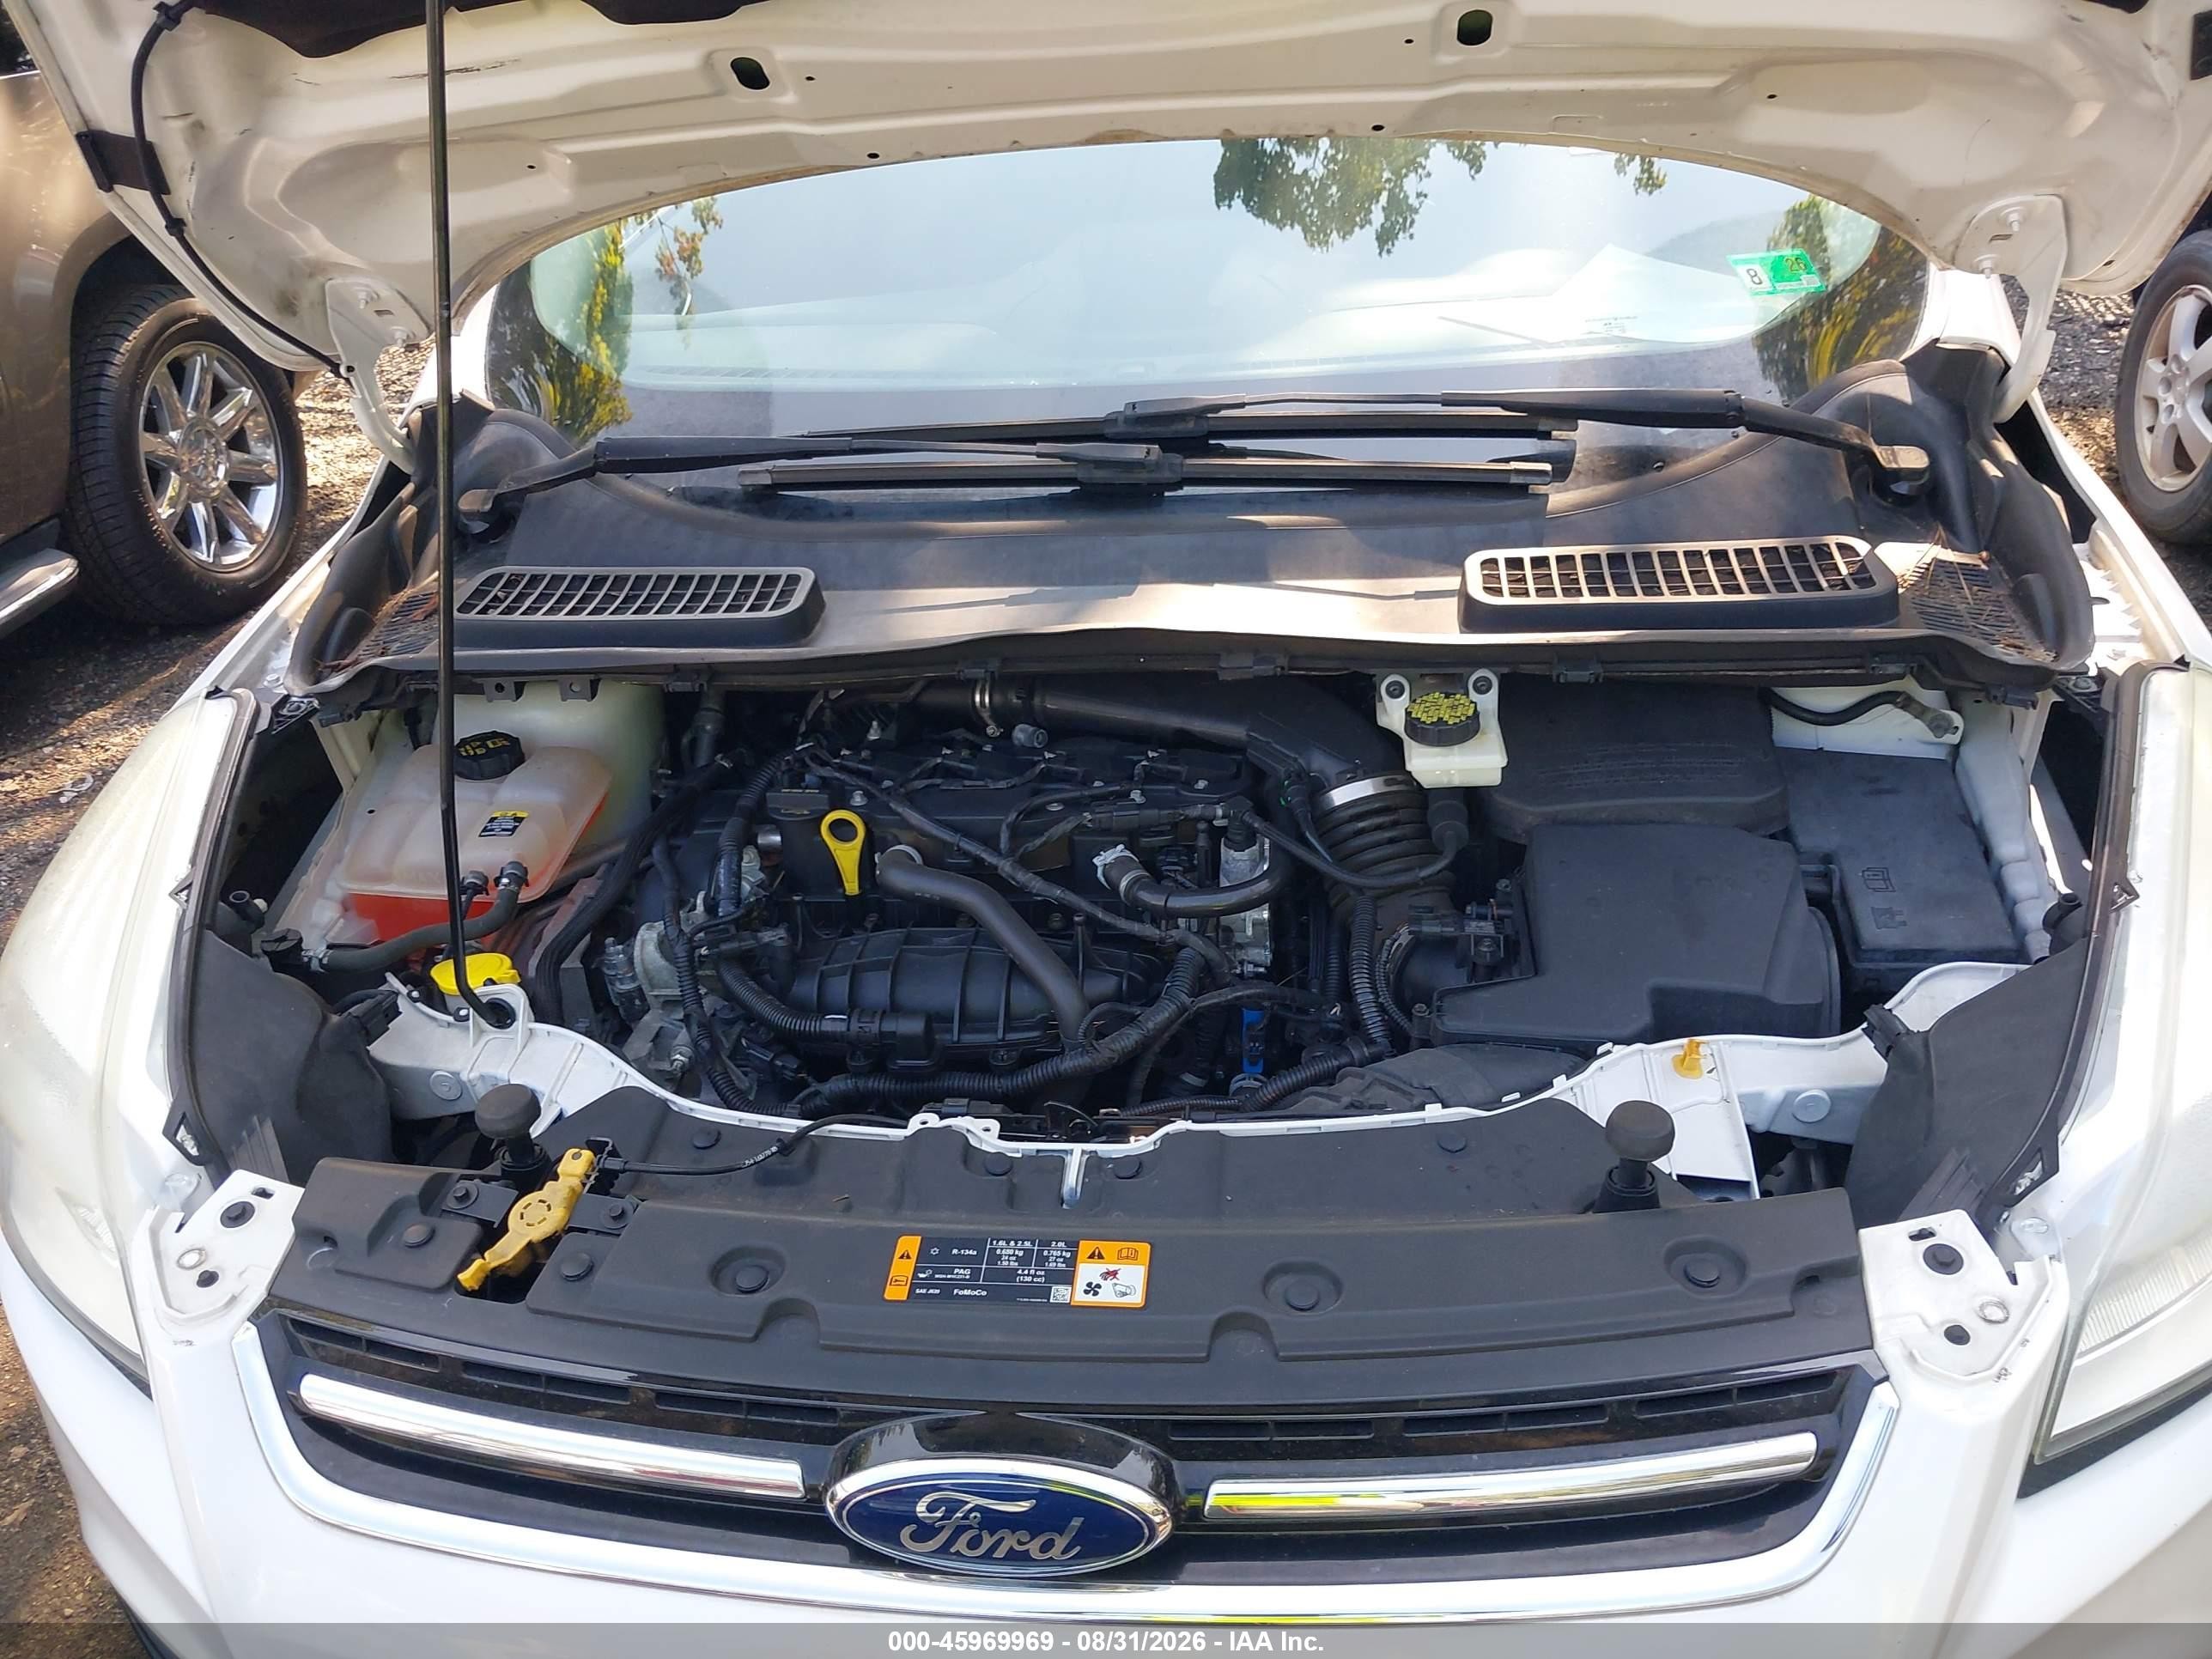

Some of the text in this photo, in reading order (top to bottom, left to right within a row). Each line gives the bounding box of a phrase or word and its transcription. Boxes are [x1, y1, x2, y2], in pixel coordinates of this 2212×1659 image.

[1784, 257, 1808, 272] 26
[1746, 267, 1764, 285] 8
[900, 1491, 1085, 1561] Ford
